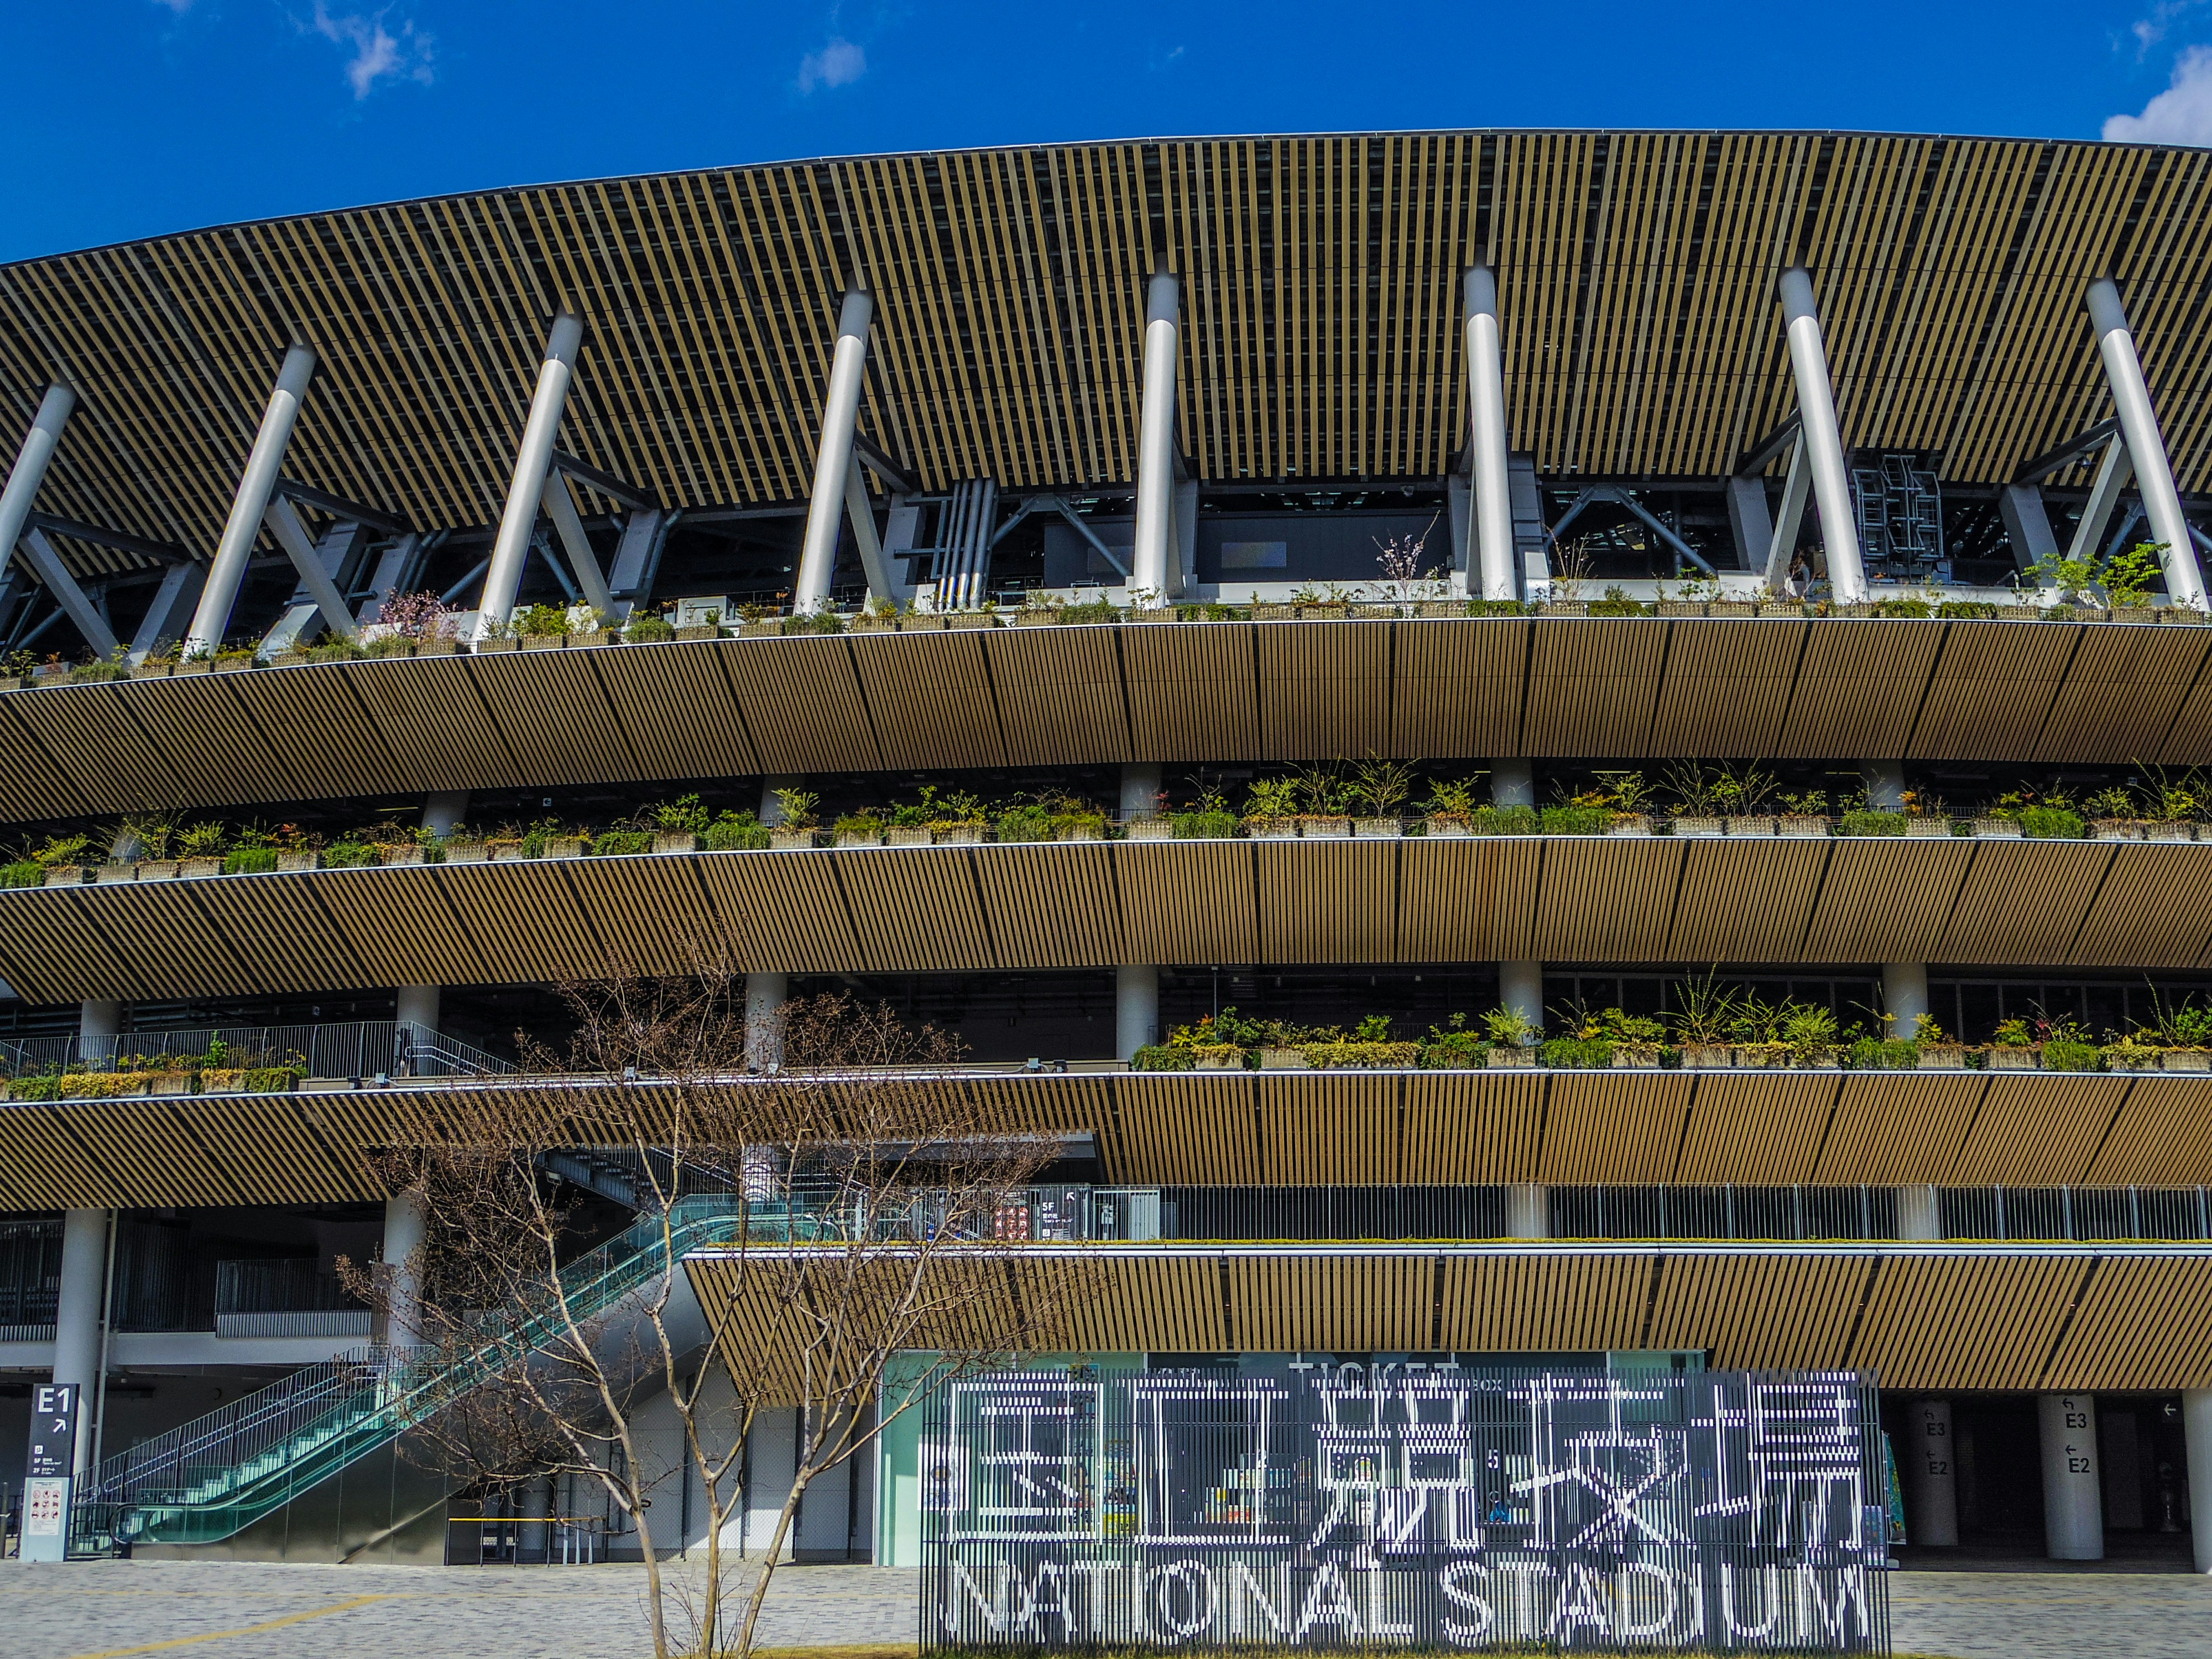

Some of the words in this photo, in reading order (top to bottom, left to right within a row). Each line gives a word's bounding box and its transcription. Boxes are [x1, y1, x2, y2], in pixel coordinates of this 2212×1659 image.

[1042, 1202, 1055, 1211] 5F
[38, 1387, 70, 1412] E1
[2065, 1413, 2087, 1428] E3
[1926, 1422, 1945, 1436] E3
[942, 1373, 1860, 1551] 国立競技場
[1929, 1461, 1948, 1475] E2
[2069, 1457, 2090, 1473] E2
[940, 1559, 1412, 1646] NATIONAL
[1440, 1560, 1868, 1648] STADIUM
